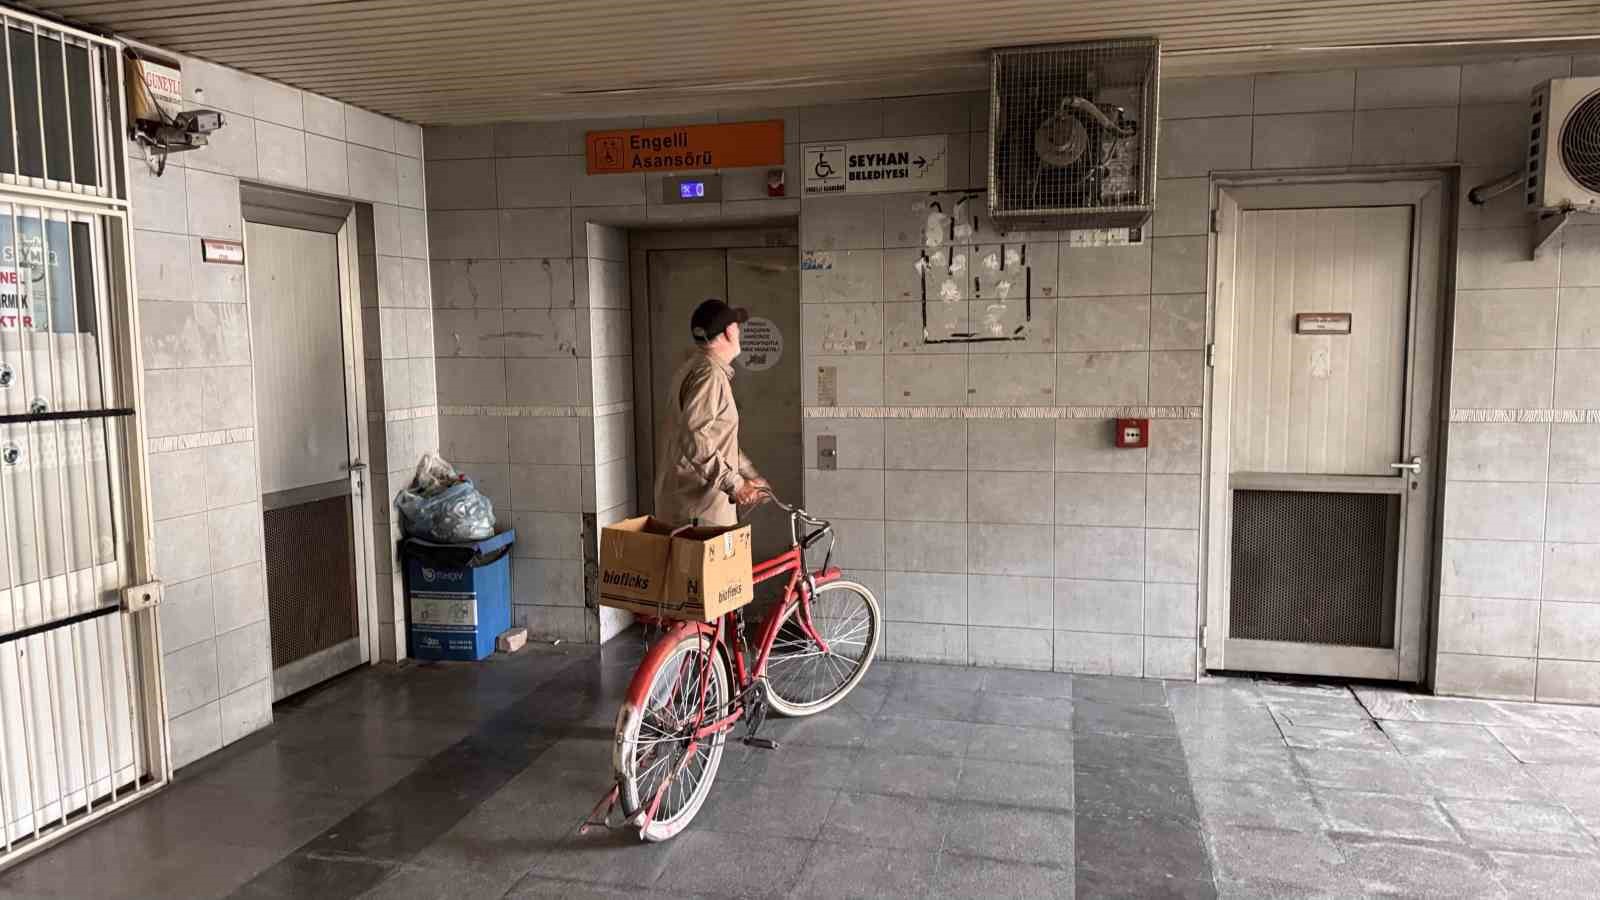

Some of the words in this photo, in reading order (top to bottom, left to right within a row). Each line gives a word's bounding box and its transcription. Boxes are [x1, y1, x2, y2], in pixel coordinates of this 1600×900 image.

[629, 132, 688, 151] Engelli
[631, 151, 713, 169] Asansörü
[848, 152, 909, 168] SEYHAN
[848, 167, 909, 181] BELEDİYESİ
[0, 293, 28, 309] RMK
[0, 315, 33, 328] KTR
